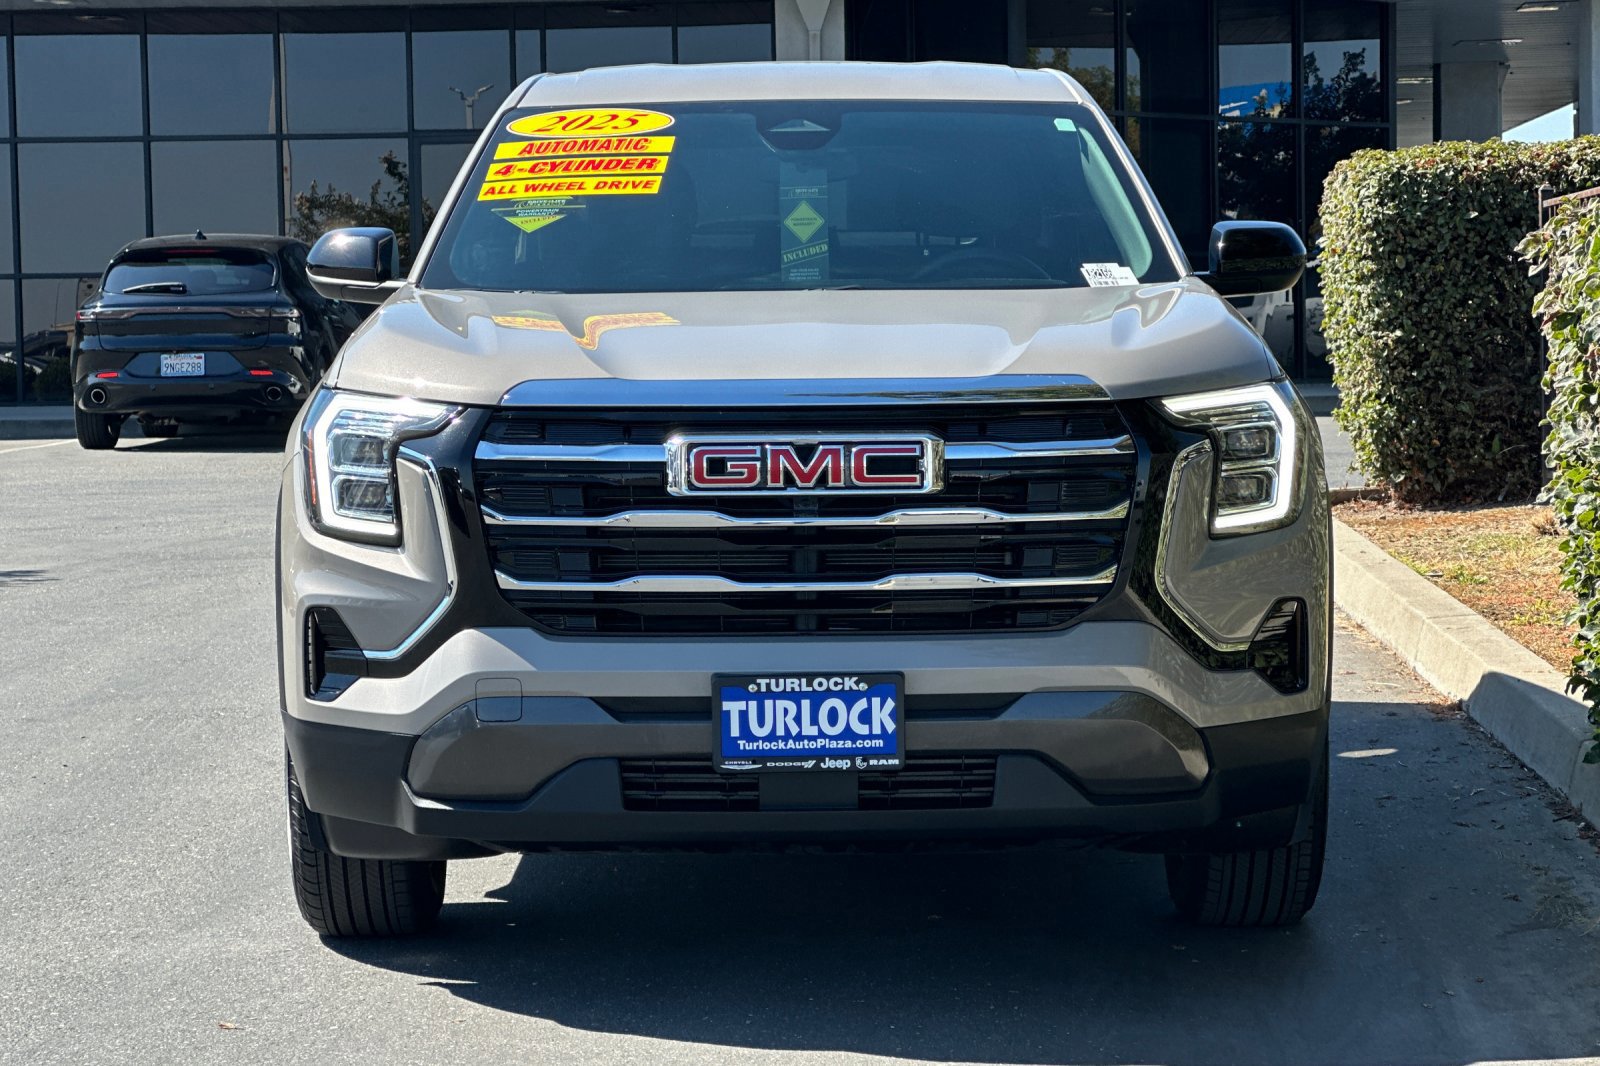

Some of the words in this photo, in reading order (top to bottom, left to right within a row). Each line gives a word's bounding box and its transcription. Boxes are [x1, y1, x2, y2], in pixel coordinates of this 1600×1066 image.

[532, 113, 649, 133] 2025
[518, 138, 651, 156] AUTOMATIC
[494, 157, 660, 177] 4-CYLINDER
[484, 185, 517, 195] ALL
[522, 182, 586, 193] WHEEL
[594, 180, 657, 190] DRIVE
[783, 243, 828, 263] INCLUDED
[690, 445, 922, 488] GMC
[756, 677, 859, 693] TURLOCK
[722, 697, 896, 737] TURLOCK
[737, 738, 884, 751] TurlockAutoPlaza.com
[820, 757, 851, 770] Jeep
